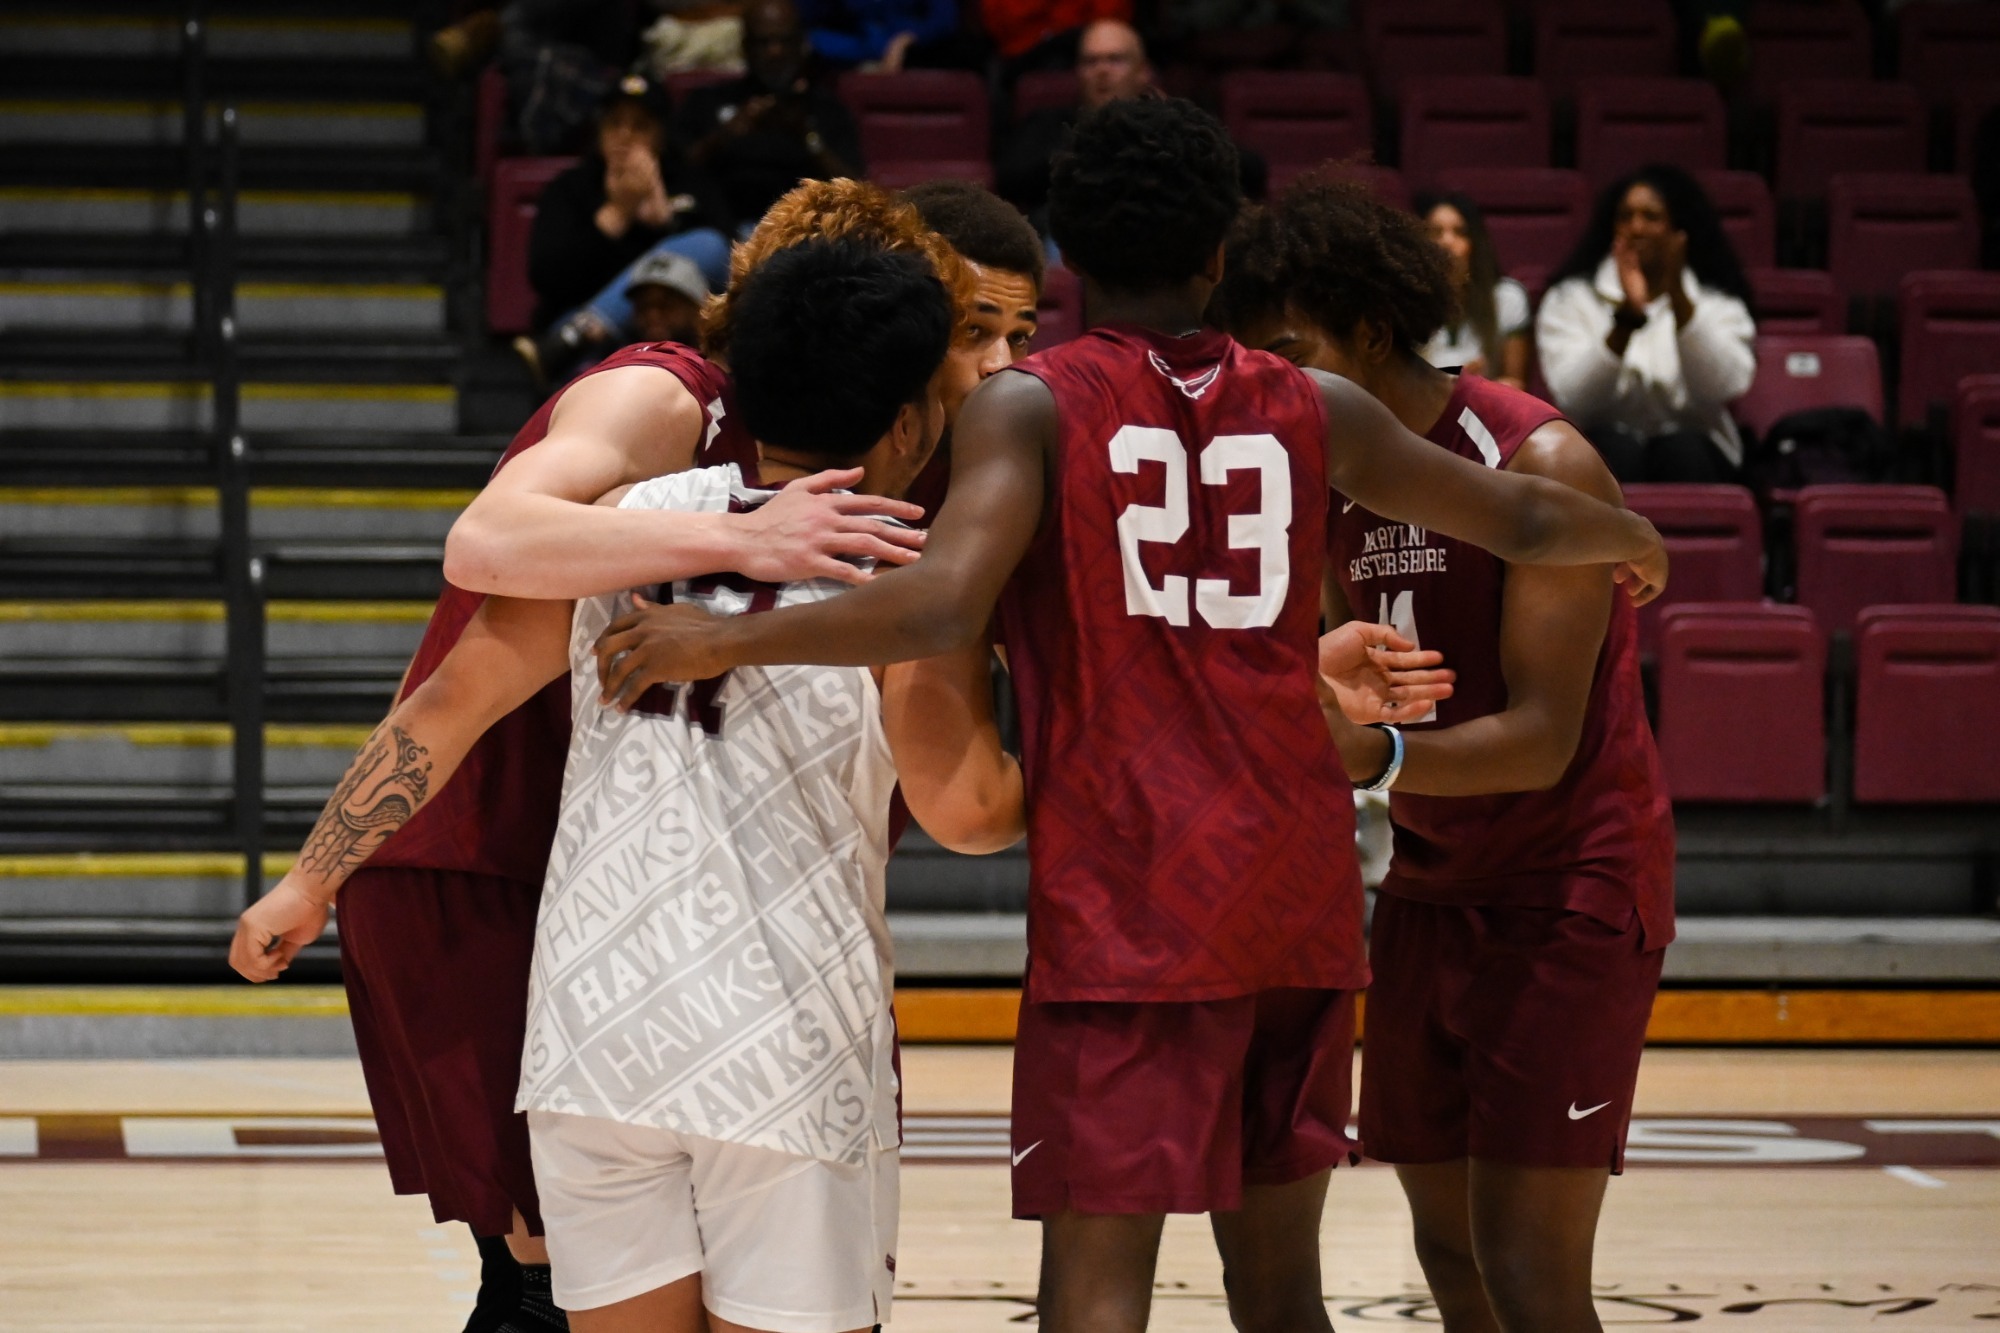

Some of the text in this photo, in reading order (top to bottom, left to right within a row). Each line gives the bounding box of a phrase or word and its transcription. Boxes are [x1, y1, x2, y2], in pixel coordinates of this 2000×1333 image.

[1108, 425, 1292, 629] 23
[543, 806, 695, 964] HAWKS
[566, 871, 739, 1027] HAWKS
[600, 940, 784, 1093] HAWKS
